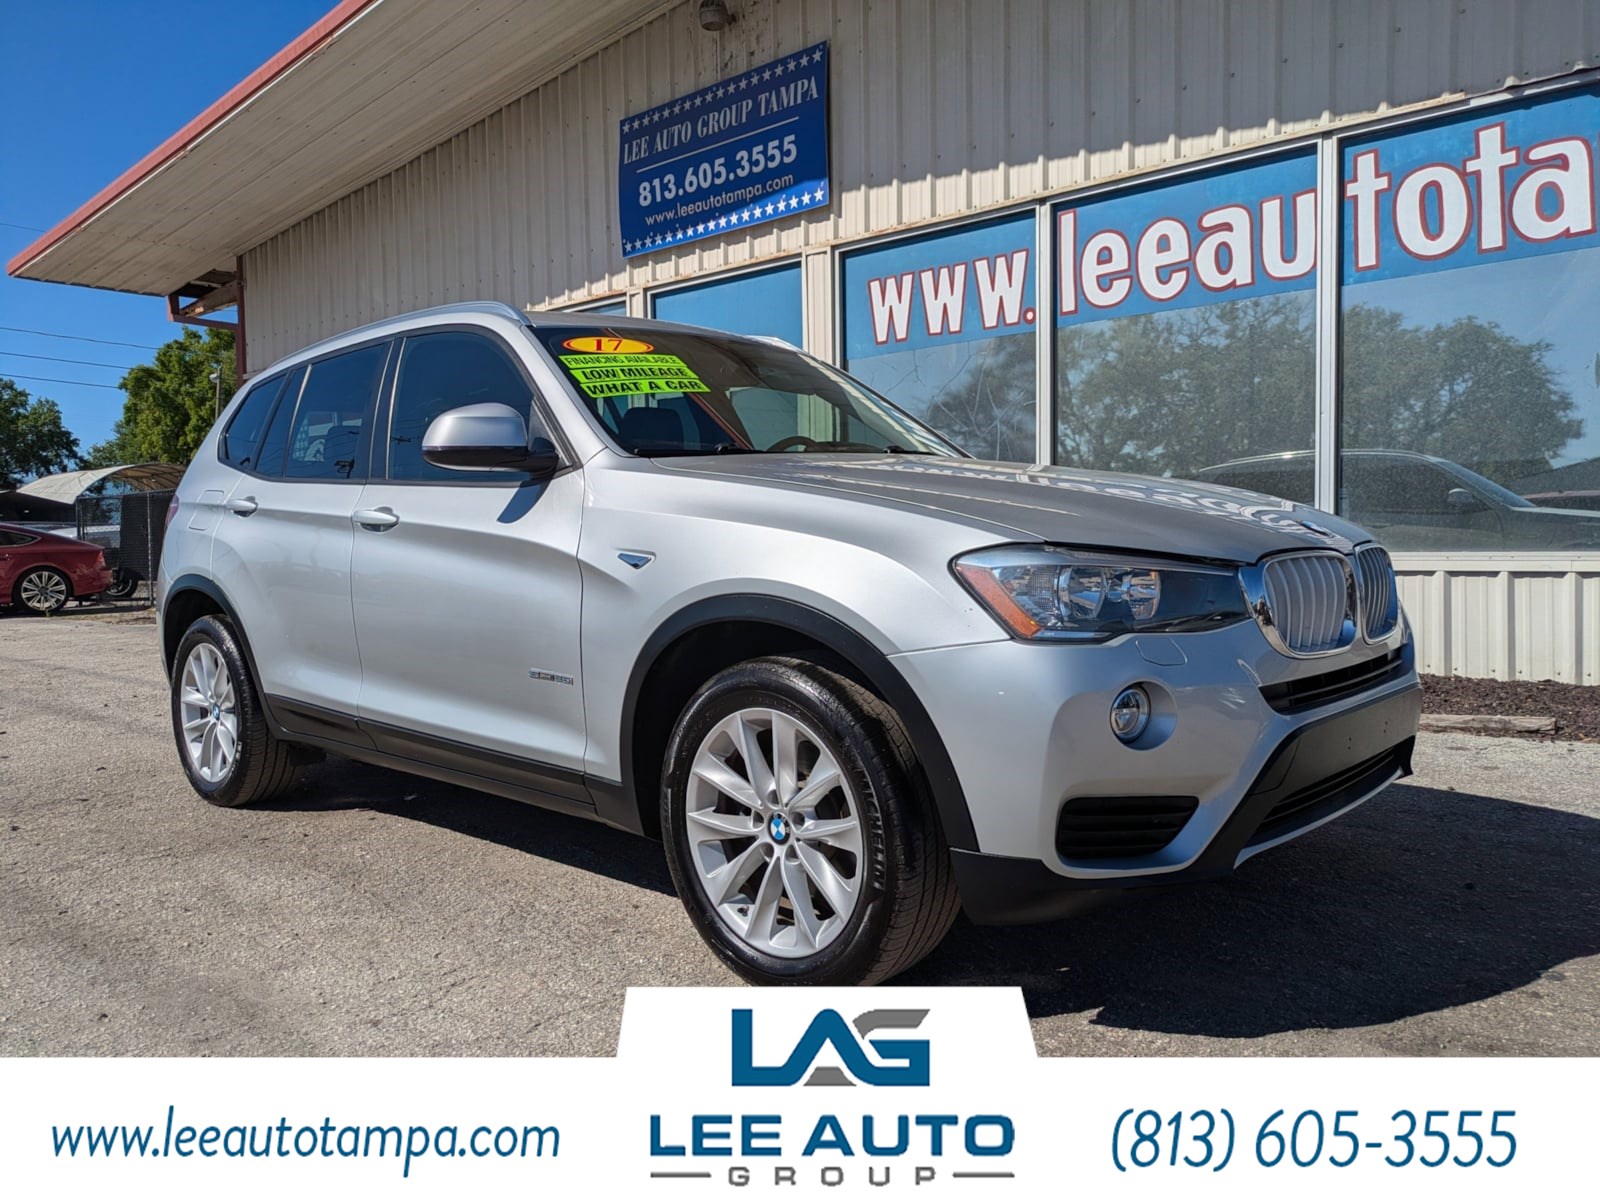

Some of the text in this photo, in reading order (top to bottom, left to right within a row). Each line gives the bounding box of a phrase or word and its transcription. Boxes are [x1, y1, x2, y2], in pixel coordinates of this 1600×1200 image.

[623, 76, 818, 165] LEE AUTO GROUP TAMPA
[638, 134, 798, 207] 813.605.3555
[645, 173, 794, 226] www.leeautotampa.com
[868, 121, 1600, 345] www.leeautota
[566, 355, 681, 367] FINANCING AVAILABLE
[595, 339, 624, 352] 17
[582, 367, 688, 381] LOW MILEAGE
[587, 379, 702, 396] WHAT A CAR
